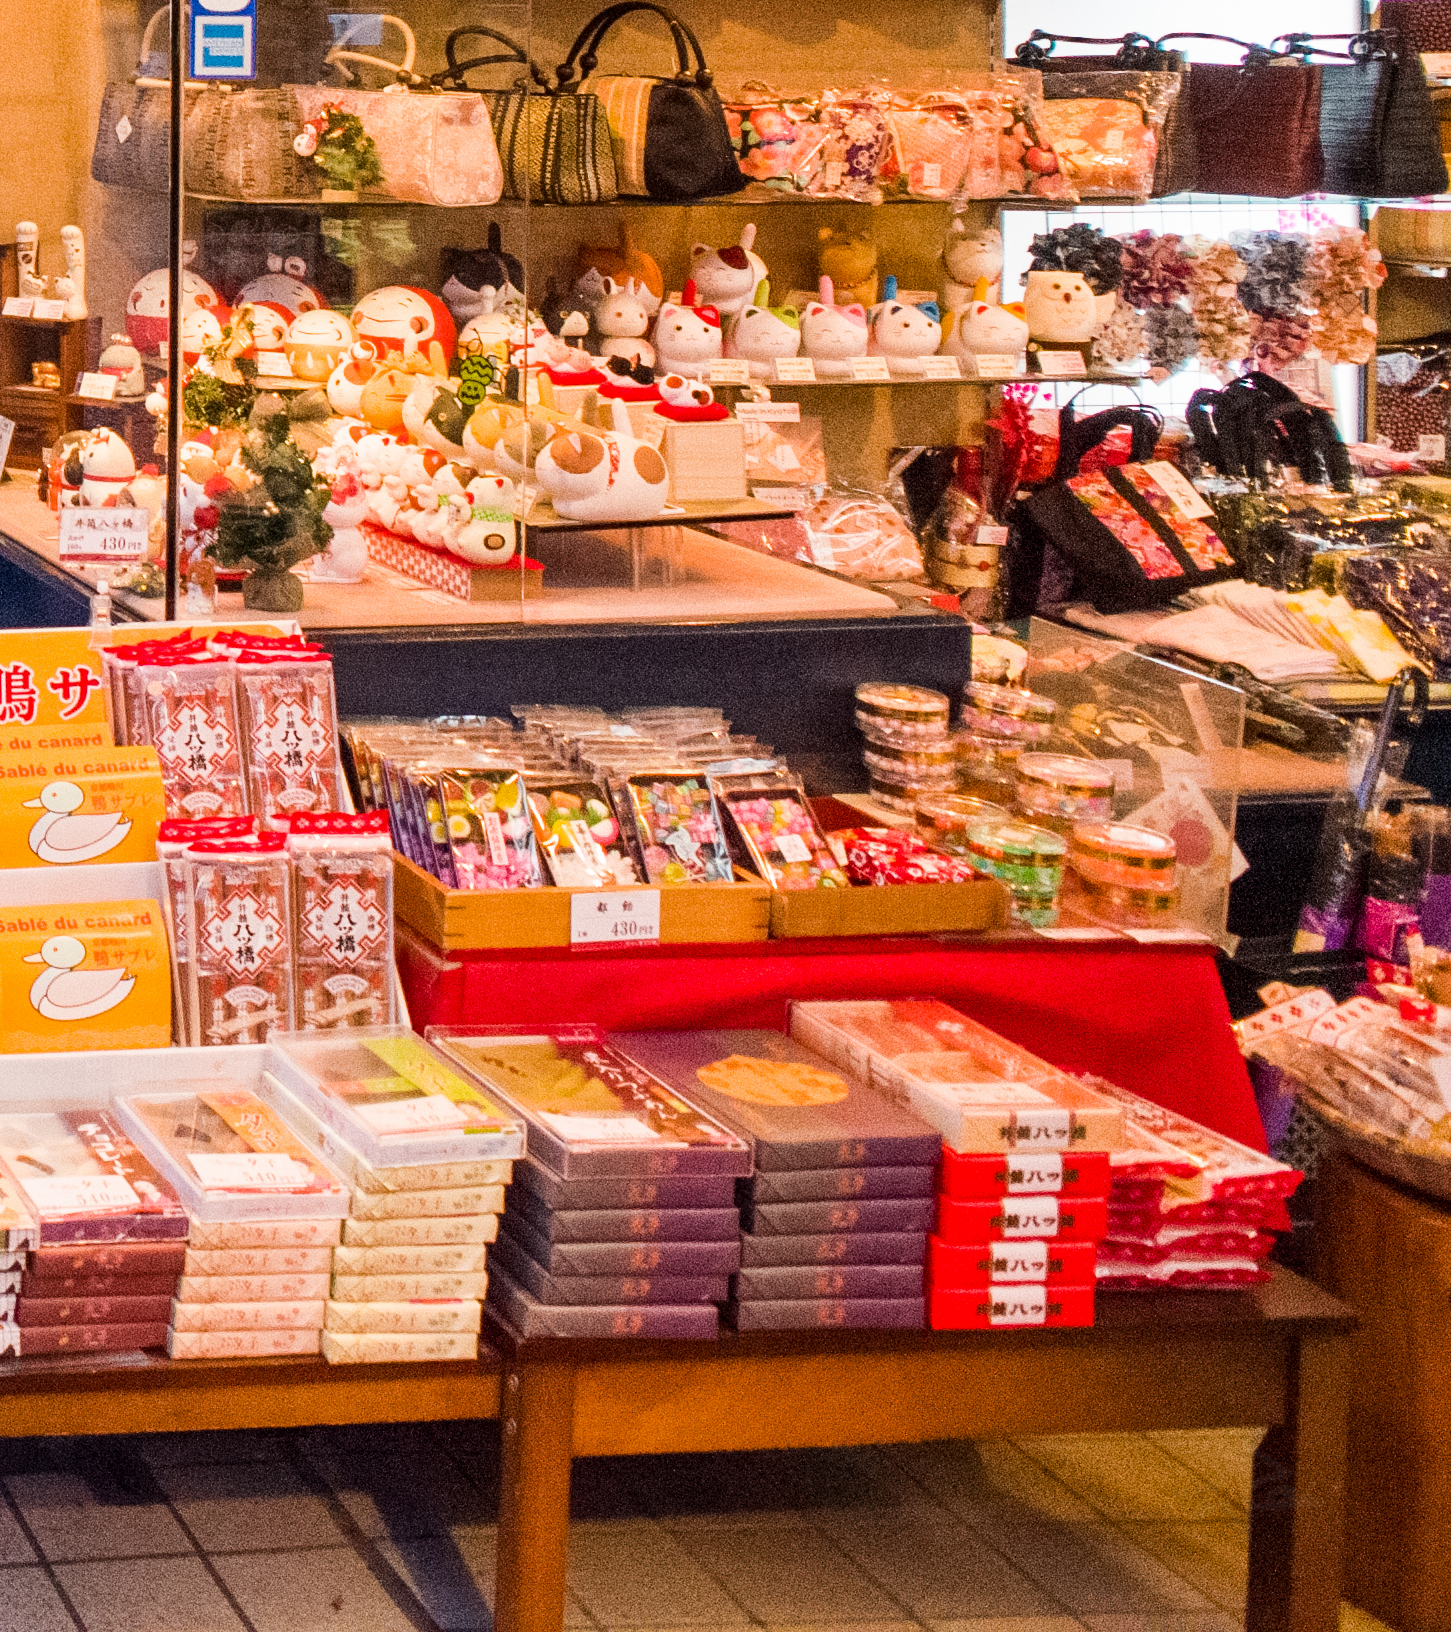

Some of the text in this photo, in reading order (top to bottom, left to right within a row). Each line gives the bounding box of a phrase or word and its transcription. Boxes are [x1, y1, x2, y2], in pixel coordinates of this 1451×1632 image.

[9, 737, 32, 750] du
[38, 734, 103, 748] canard
[53, 762, 78, 776] du
[54, 916, 79, 930] du
